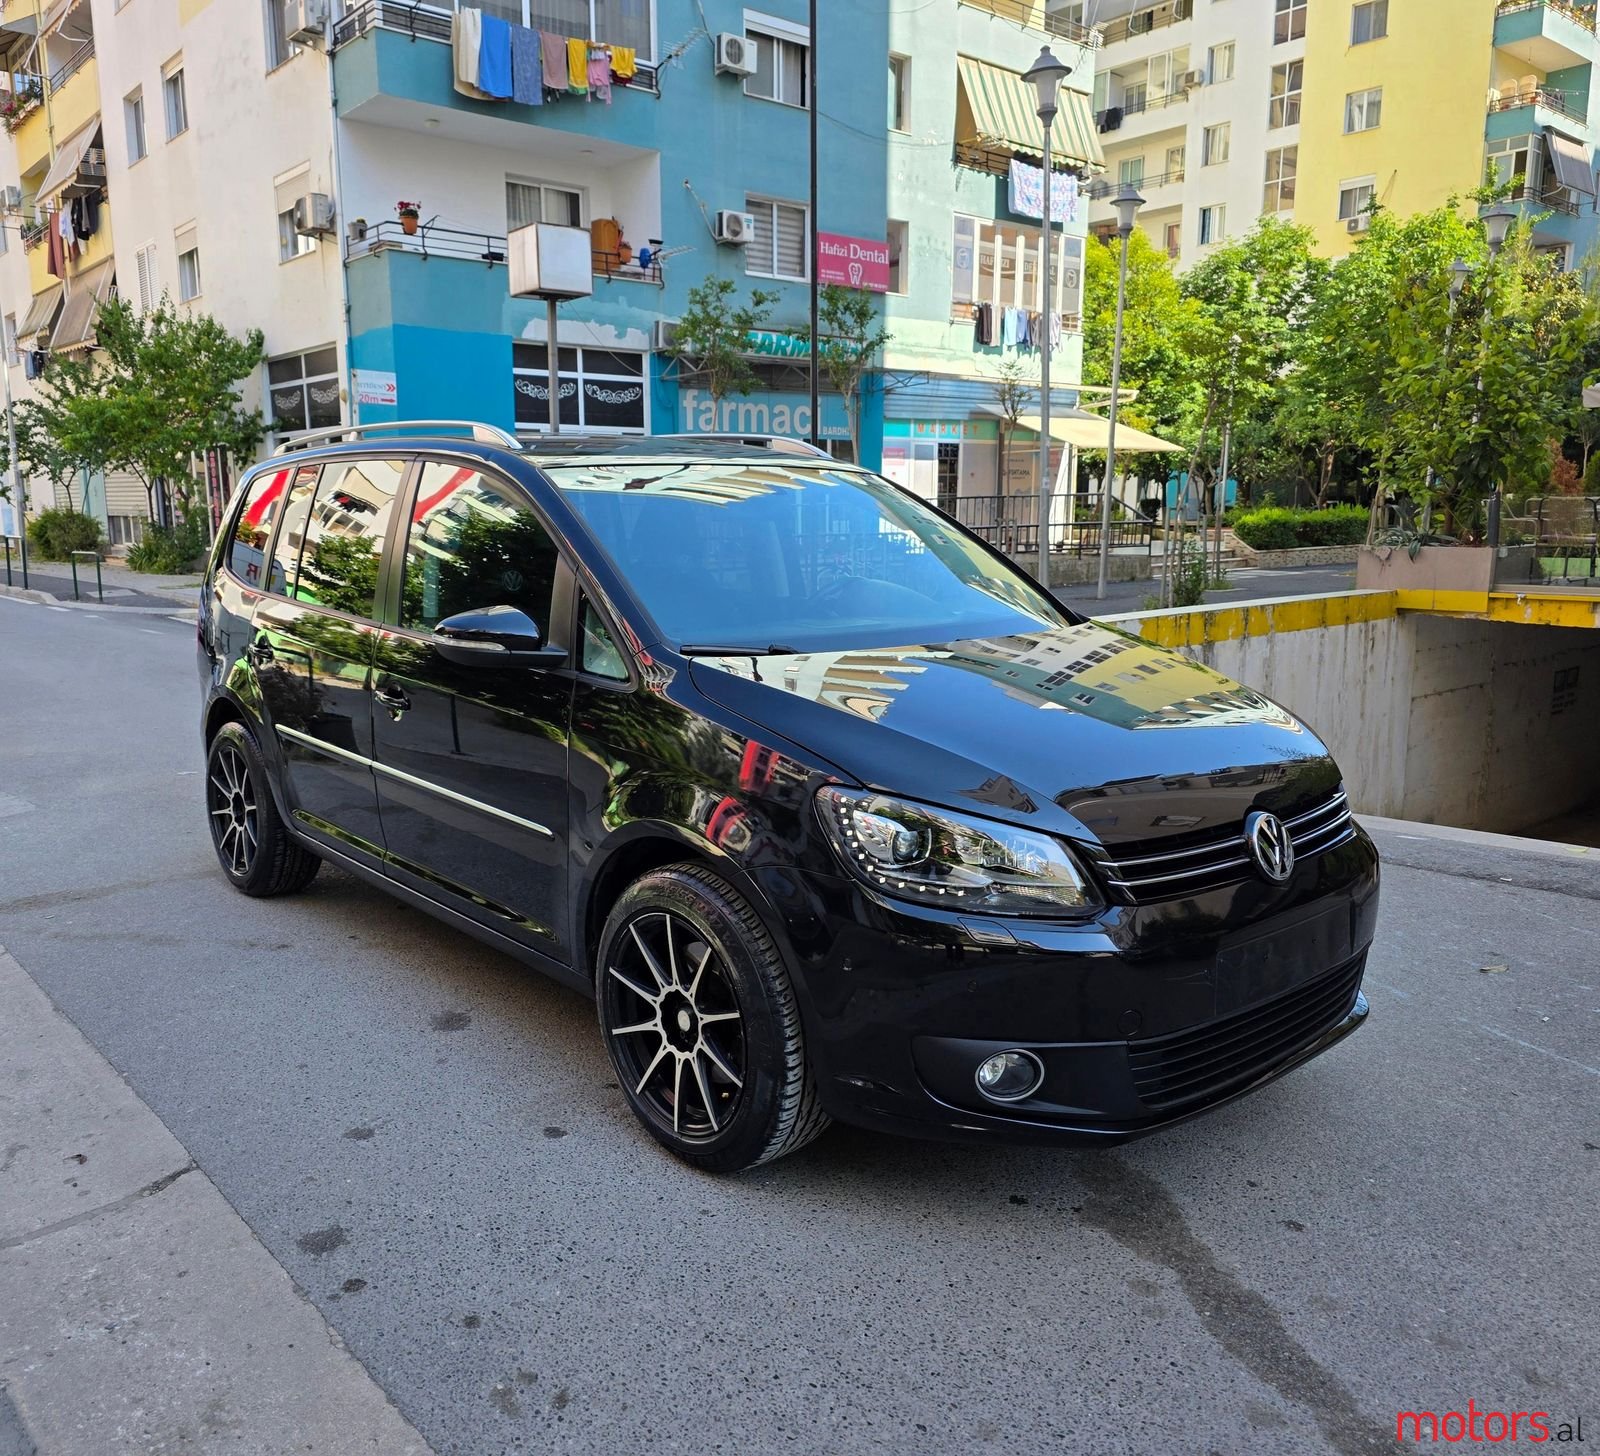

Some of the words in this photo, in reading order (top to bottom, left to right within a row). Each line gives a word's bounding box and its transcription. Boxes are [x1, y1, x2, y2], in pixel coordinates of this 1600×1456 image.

[820, 241, 848, 257] Hafizi
[849, 243, 889, 264] Dental
[917, 422, 978, 435] MARKET
